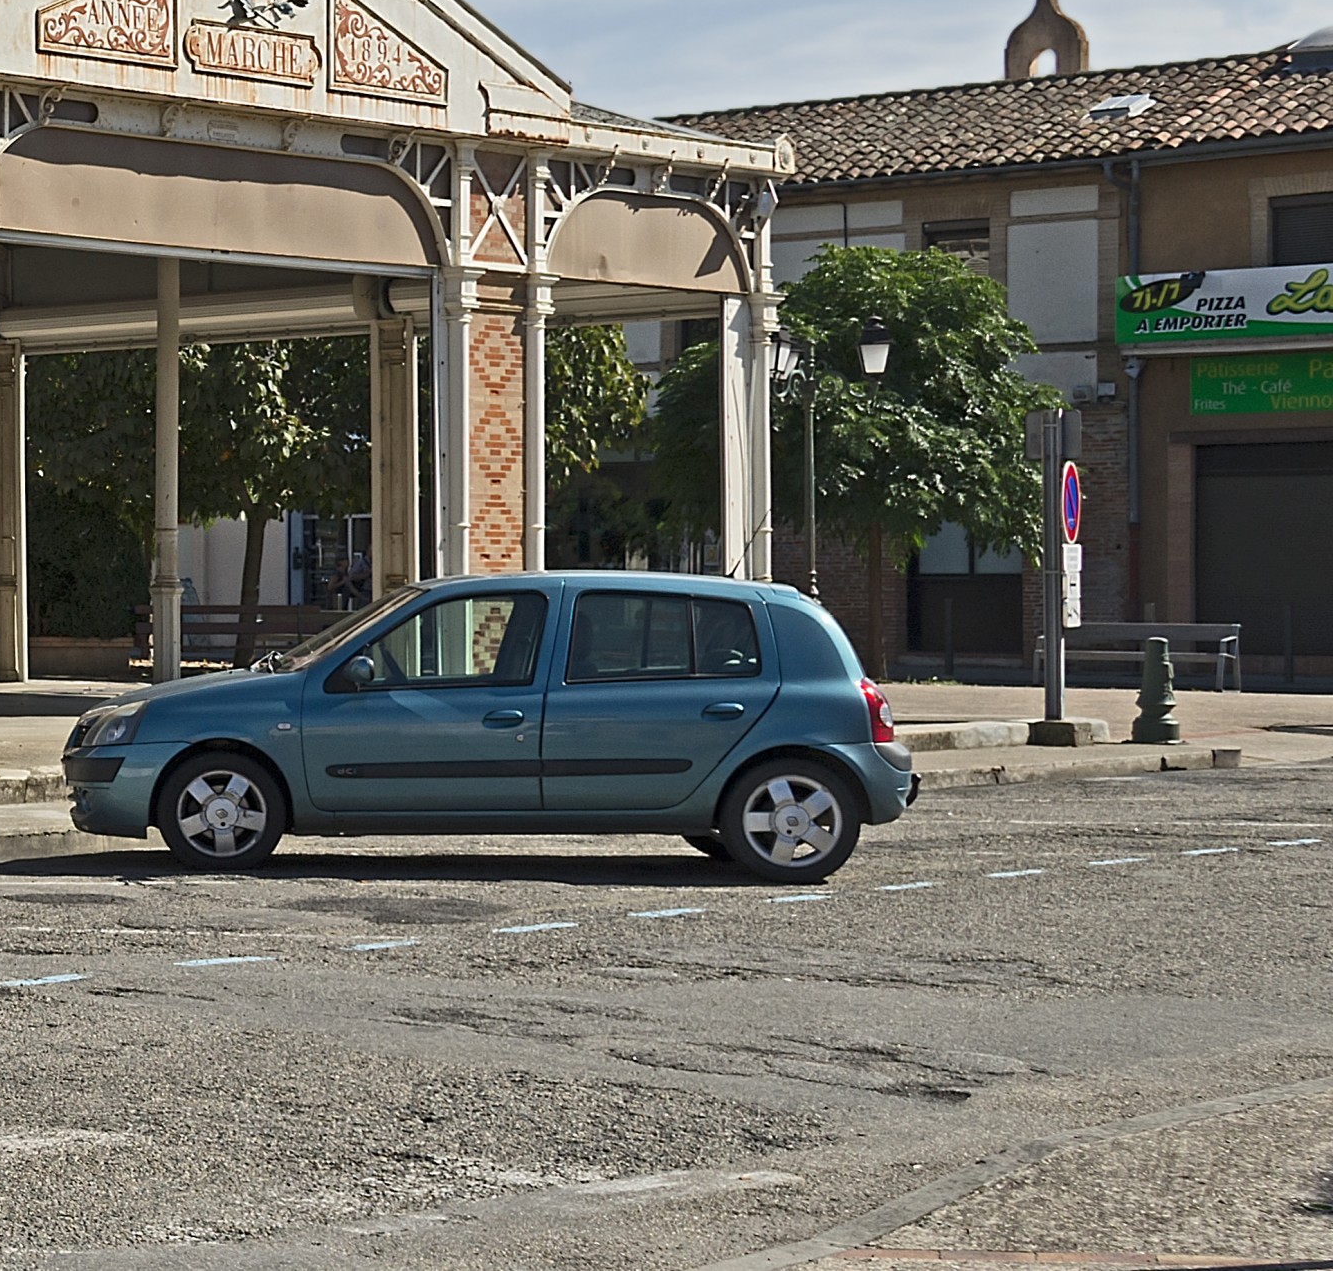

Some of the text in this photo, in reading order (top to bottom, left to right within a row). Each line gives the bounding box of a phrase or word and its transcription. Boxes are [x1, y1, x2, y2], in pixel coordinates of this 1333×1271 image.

[1196, 296, 1245, 311] PIZZA
[1135, 313, 1247, 334] A EMPORTER
[1221, 380, 1247, 395] Thé
[1260, 378, 1292, 394] Café
[1194, 398, 1226, 410] Frites
